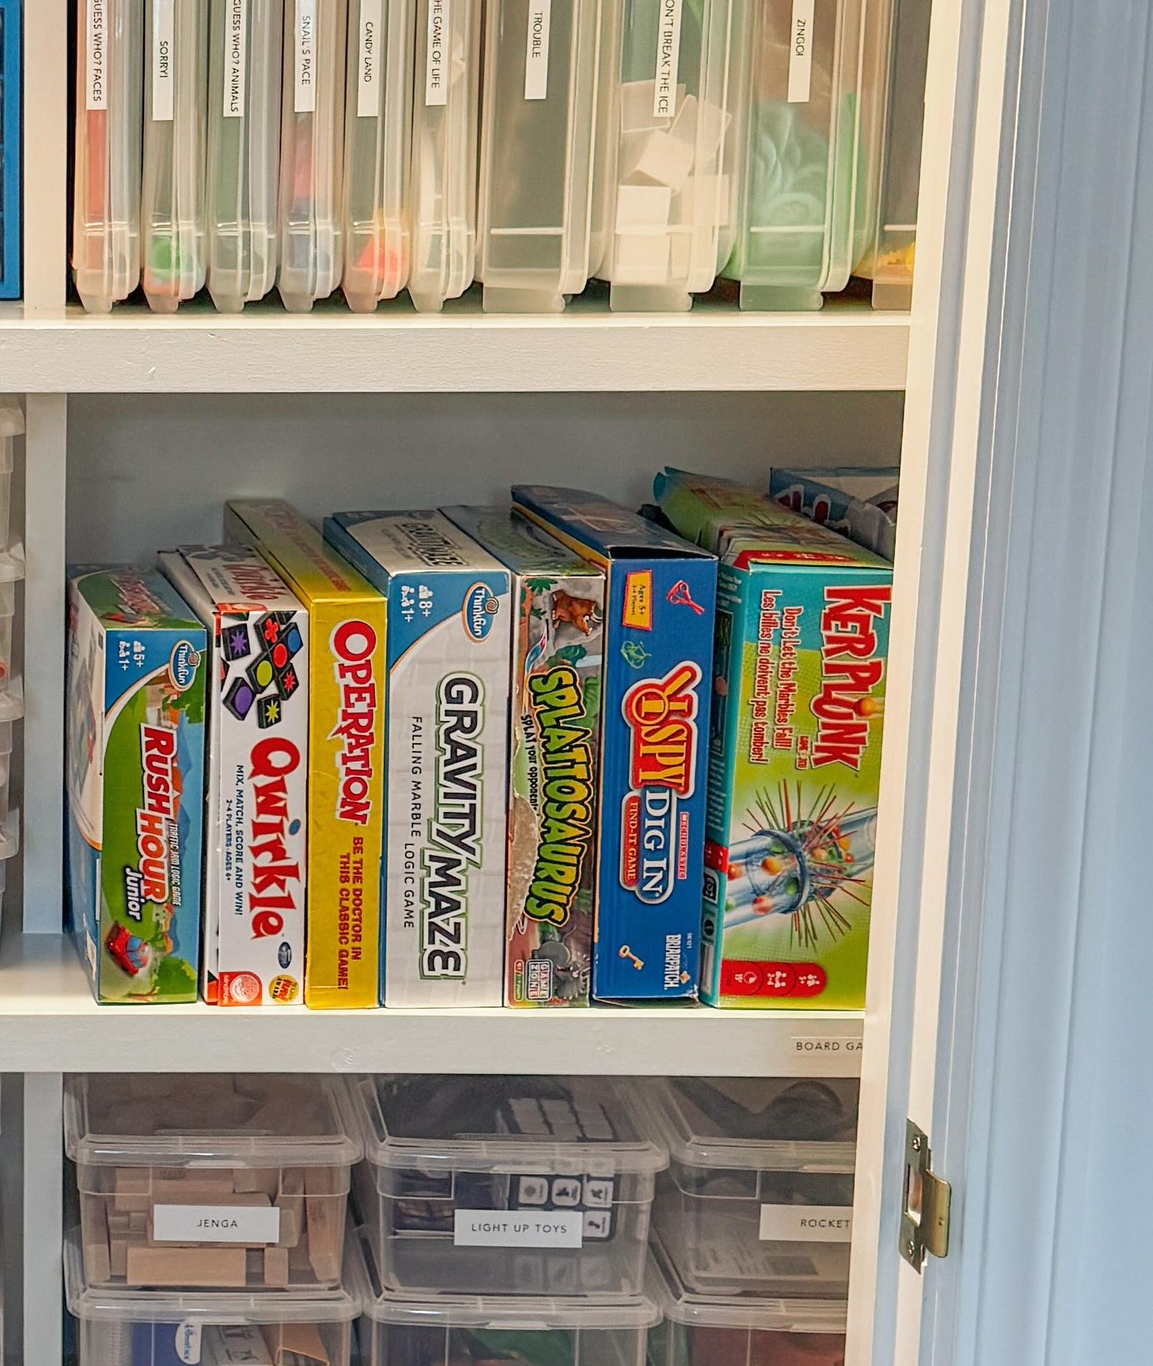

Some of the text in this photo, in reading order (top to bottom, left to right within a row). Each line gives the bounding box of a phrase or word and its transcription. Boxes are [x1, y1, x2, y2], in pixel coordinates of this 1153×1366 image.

[93, 32, 103, 65] WHO?
[231, 32, 241, 65] WHO?
[301, 15, 311, 85] SNAIL'S PACE
[363, 21, 374, 83] CANDY LAND
[431, 50, 441, 65] OF
[432, 16, 442, 48] GAME
[531, 11, 543, 58] TROUBLE
[660, 31, 673, 68] BREAK
[92, 67, 102, 102] FACES
[230, 67, 240, 113] ANIMALS
[430, 68, 440, 89] LIFE
[658, 95, 669, 113] ICE
[659, 71, 670, 93] THE
[810, 586, 892, 772] KERPLUNK
[332, 620, 377, 825] OPERATION
[144, 726, 175, 816] RUSH
[410, 716, 422, 837] FALLING MARBLE
[435, 676, 479, 857] GRAVITY
[139, 811, 167, 901] HOUR
[234, 764, 245, 916] MIX, MATCH, SCORE AND WIN!
[247, 737, 301, 939] Qwirkle
[627, 802, 639, 880] FIND-IT GAME
[642, 789, 670, 893] DIG IN
[125, 867, 144, 921] Junior
[351, 836, 363, 961] BE THE DOCTOR IN
[403, 843, 415, 928] LOGIC GAME
[427, 854, 463, 972] MAZE
[337, 853, 350, 990] THIS CLASSIC GAME!
[196, 1219, 238, 1228] JENGA
[471, 1223, 567, 1234] LIGHT UP TOYS
